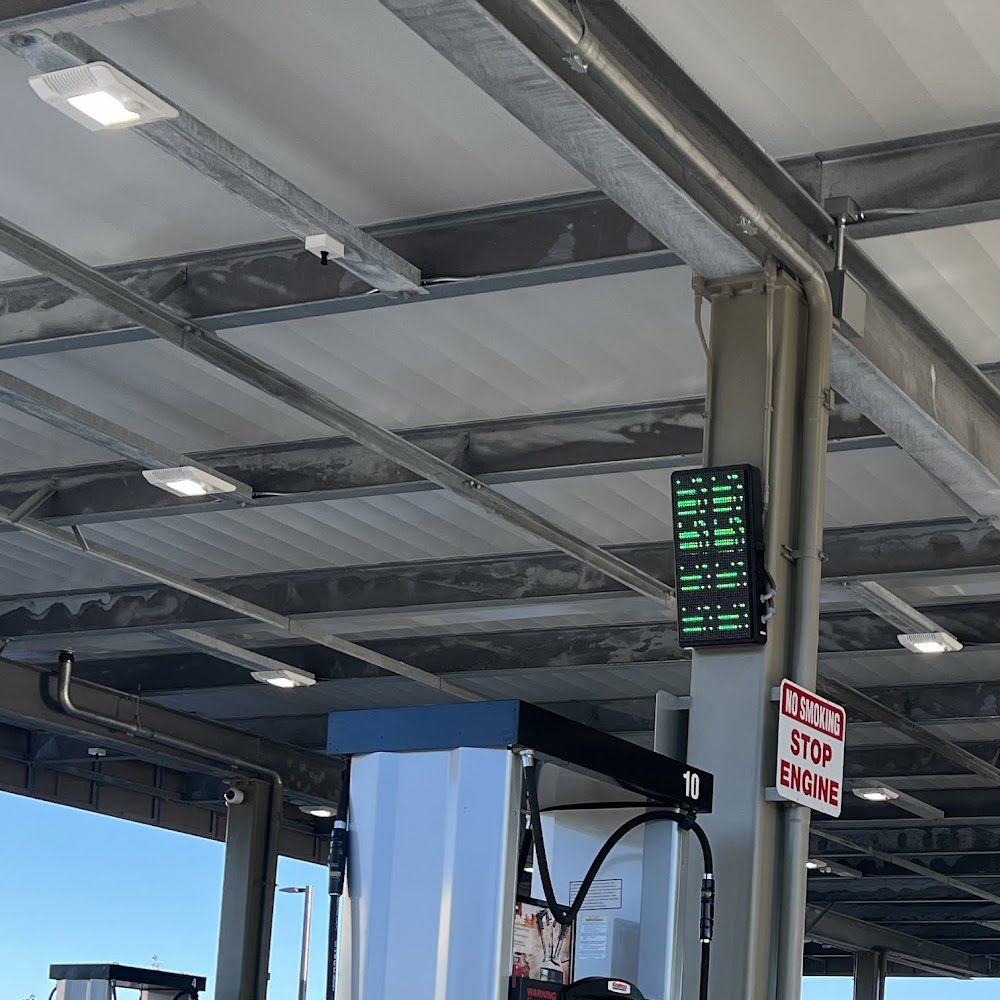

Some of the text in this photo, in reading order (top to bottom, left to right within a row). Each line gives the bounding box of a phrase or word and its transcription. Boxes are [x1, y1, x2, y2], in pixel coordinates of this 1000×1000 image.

[785, 688, 841, 737] NO SMOKING
[790, 728, 832, 768] STOP
[683, 770, 700, 800] 10
[780, 759, 839, 807] ENGINE
[191, 977, 197, 989] 4
[527, 987, 557, 1000] WARNING
